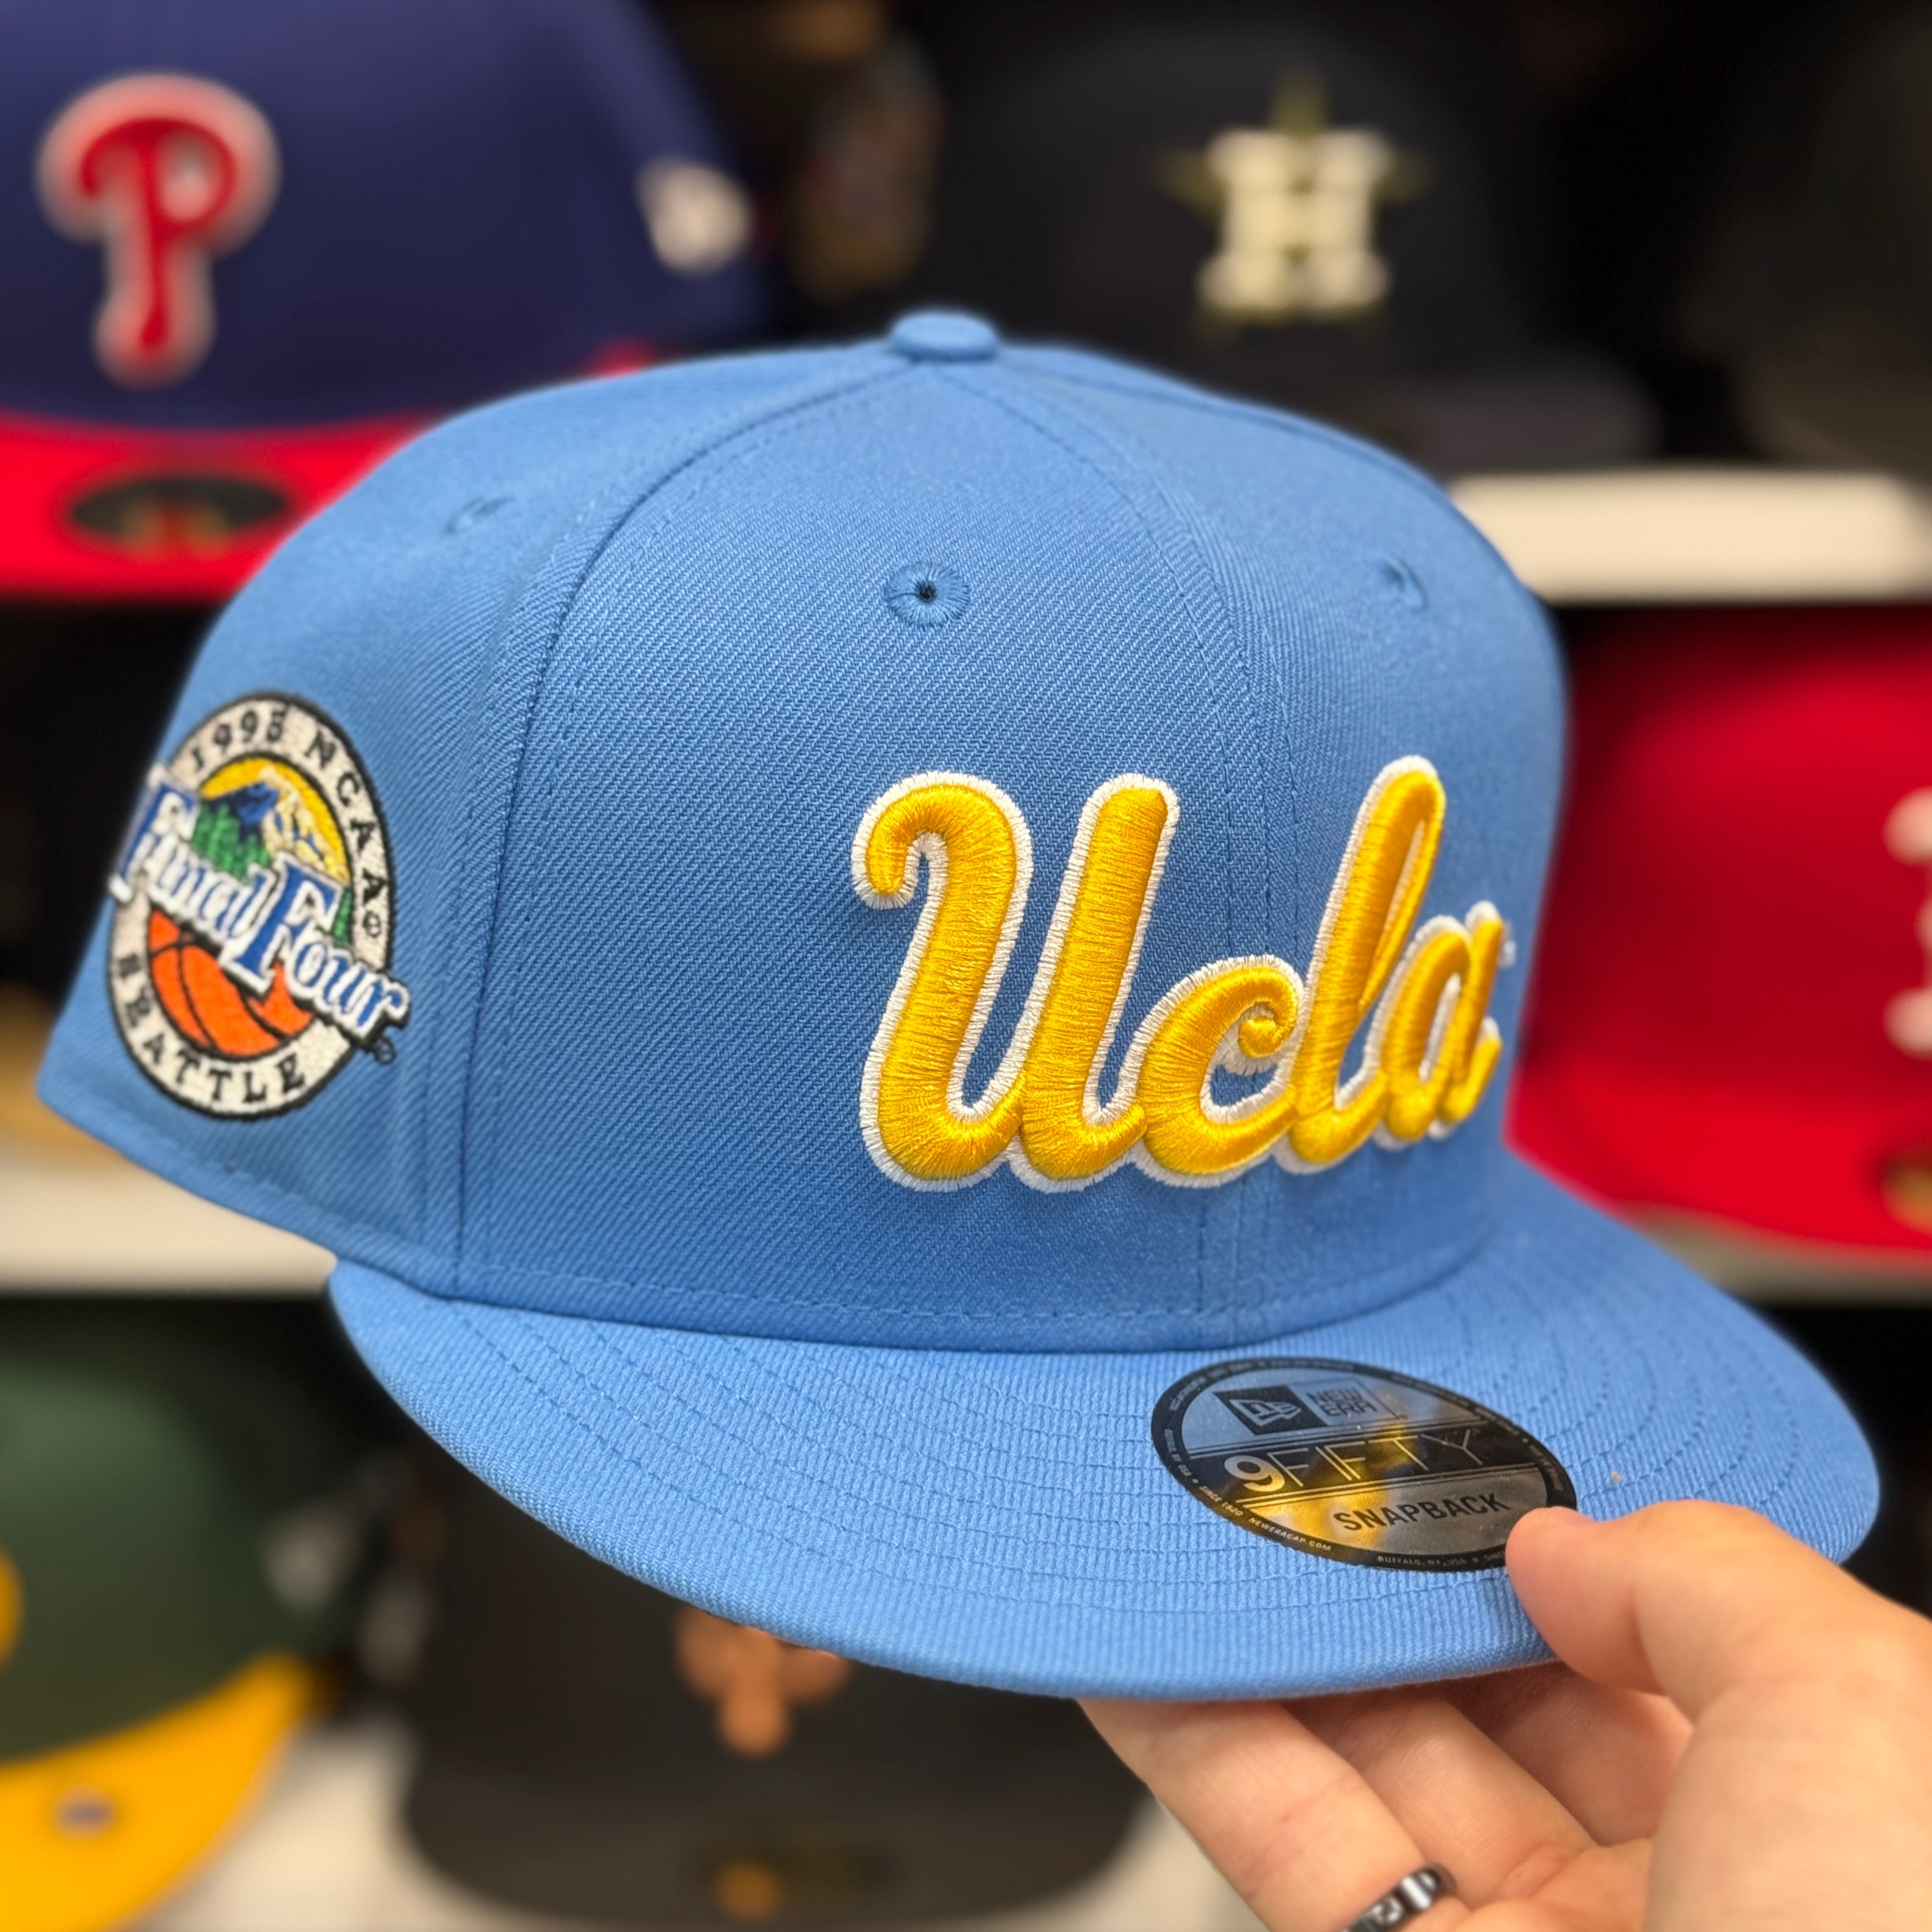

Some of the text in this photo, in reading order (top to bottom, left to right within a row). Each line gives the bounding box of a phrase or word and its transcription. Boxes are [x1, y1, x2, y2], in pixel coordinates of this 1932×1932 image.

[36, 73, 282, 384] P
[109, 763, 410, 1041] Final Four
[1304, 1386, 1364, 1406] NEW
[1320, 1396, 1378, 1417] ERA
[1224, 1428, 1484, 1493] 9FIFTY
[1333, 1492, 1511, 1531] SNAPBACK
[1248, 1517, 1332, 1552] NEWERACAP.COM
